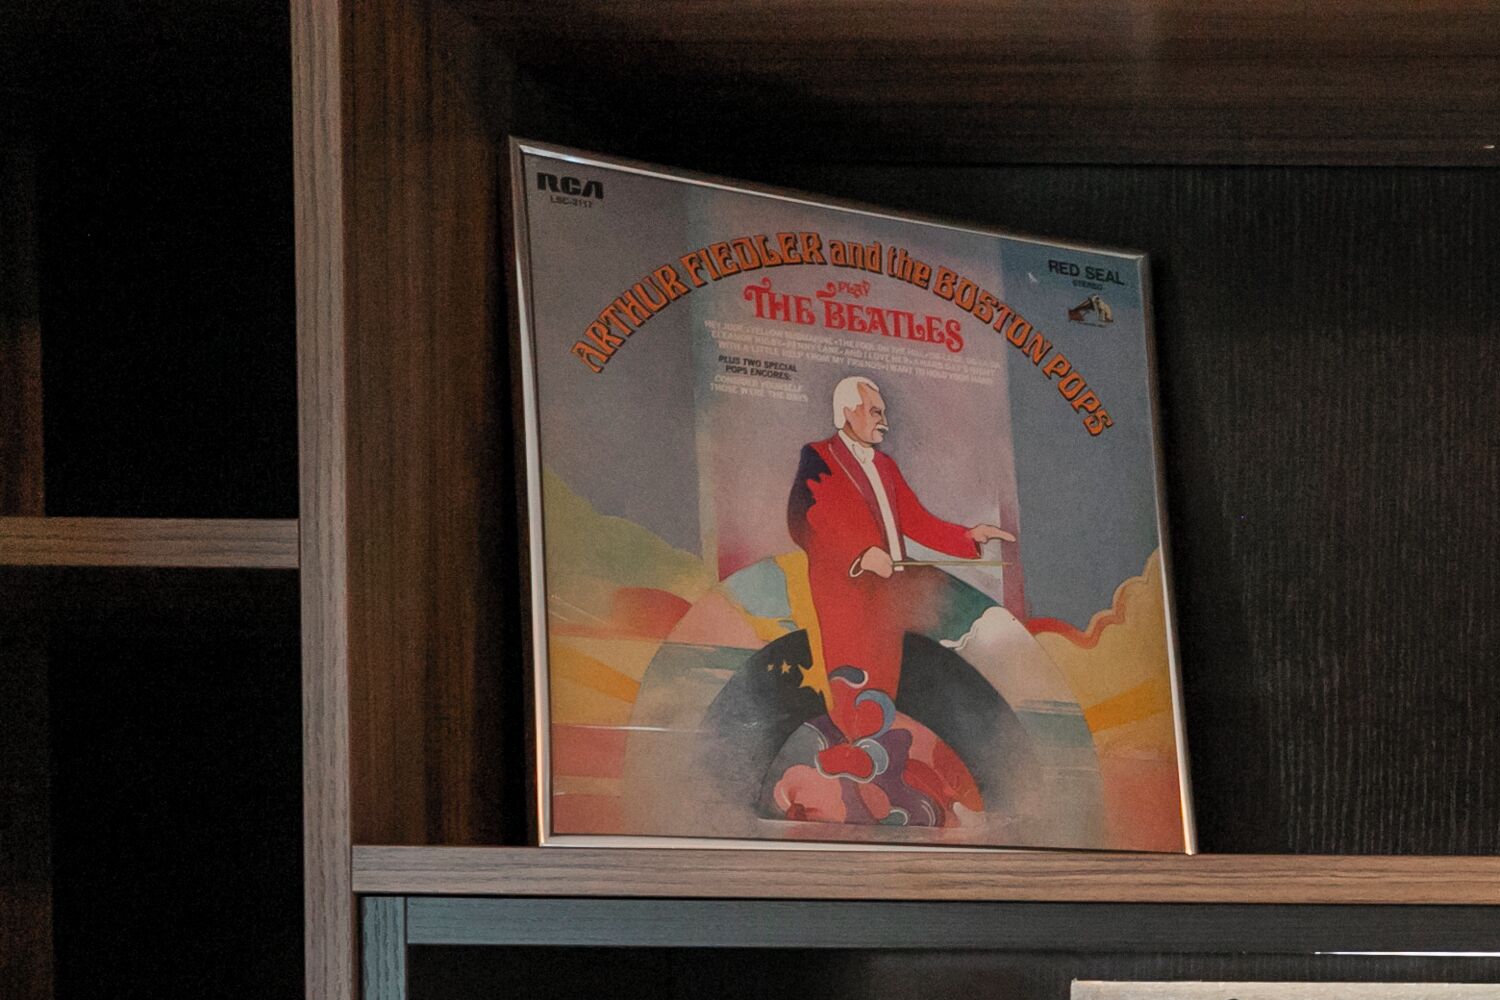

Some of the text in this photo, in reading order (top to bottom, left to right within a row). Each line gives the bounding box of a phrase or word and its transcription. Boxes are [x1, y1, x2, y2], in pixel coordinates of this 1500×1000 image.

[537, 172, 604, 199] RCA
[1048, 260, 1125, 286] RED SEAL
[744, 277, 964, 353] THE BEATLES
[570, 232, 1114, 436] ARTHUR FIEDLER and the BOSTON POPS
[763, 362, 798, 371] SPECIAL
